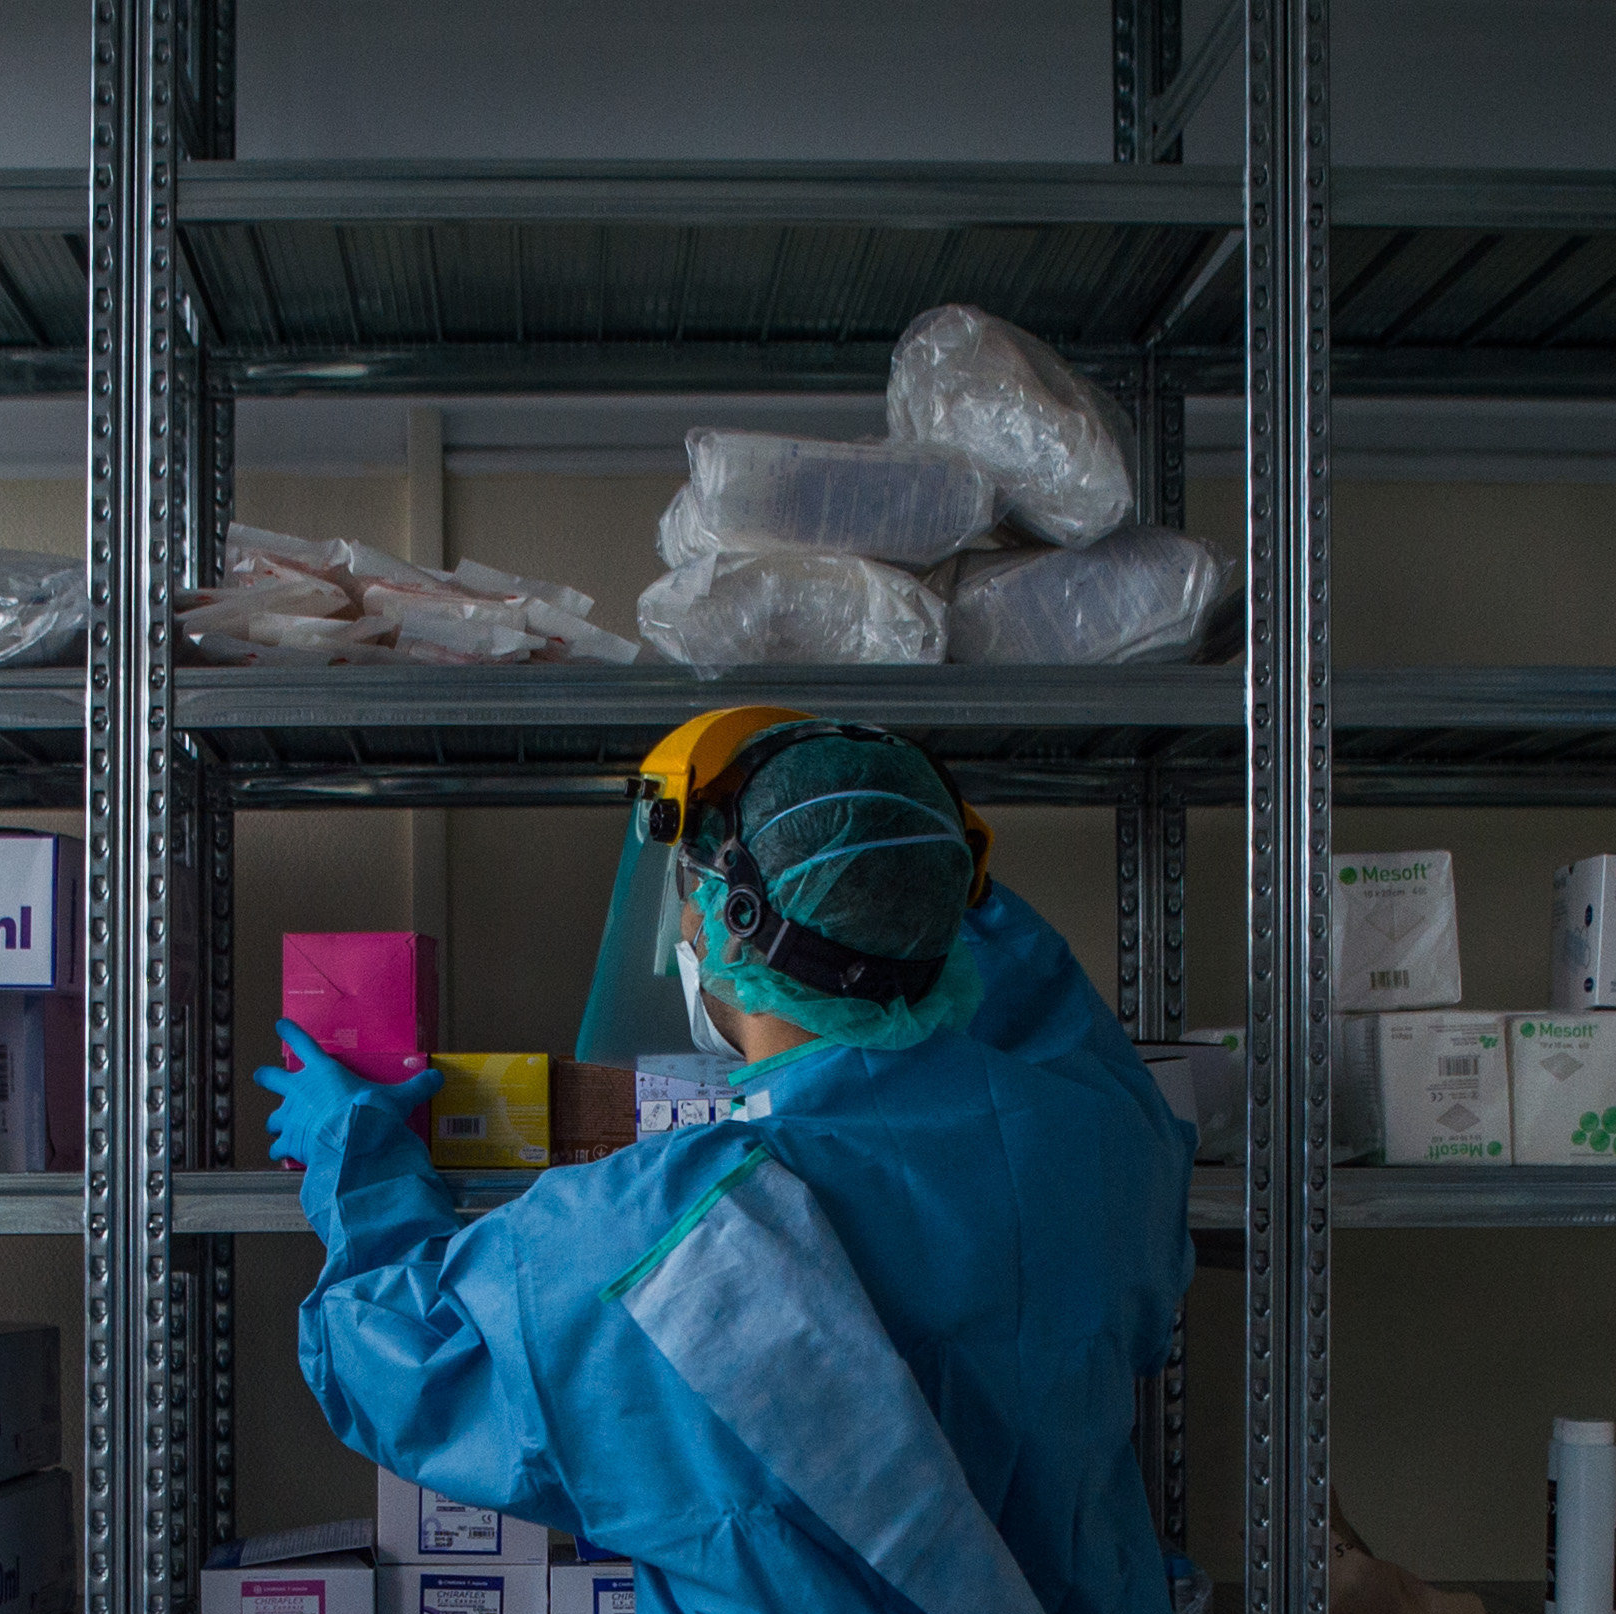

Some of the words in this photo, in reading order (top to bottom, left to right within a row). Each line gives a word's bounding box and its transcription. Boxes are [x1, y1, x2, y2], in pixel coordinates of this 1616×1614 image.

[1362, 863, 1427, 884] Mesoft
[1540, 1022, 1593, 1038] Mesoft
[1429, 1142, 1483, 1159] Mesoft
[437, 1591, 486, 1599] CHIRAFLEX
